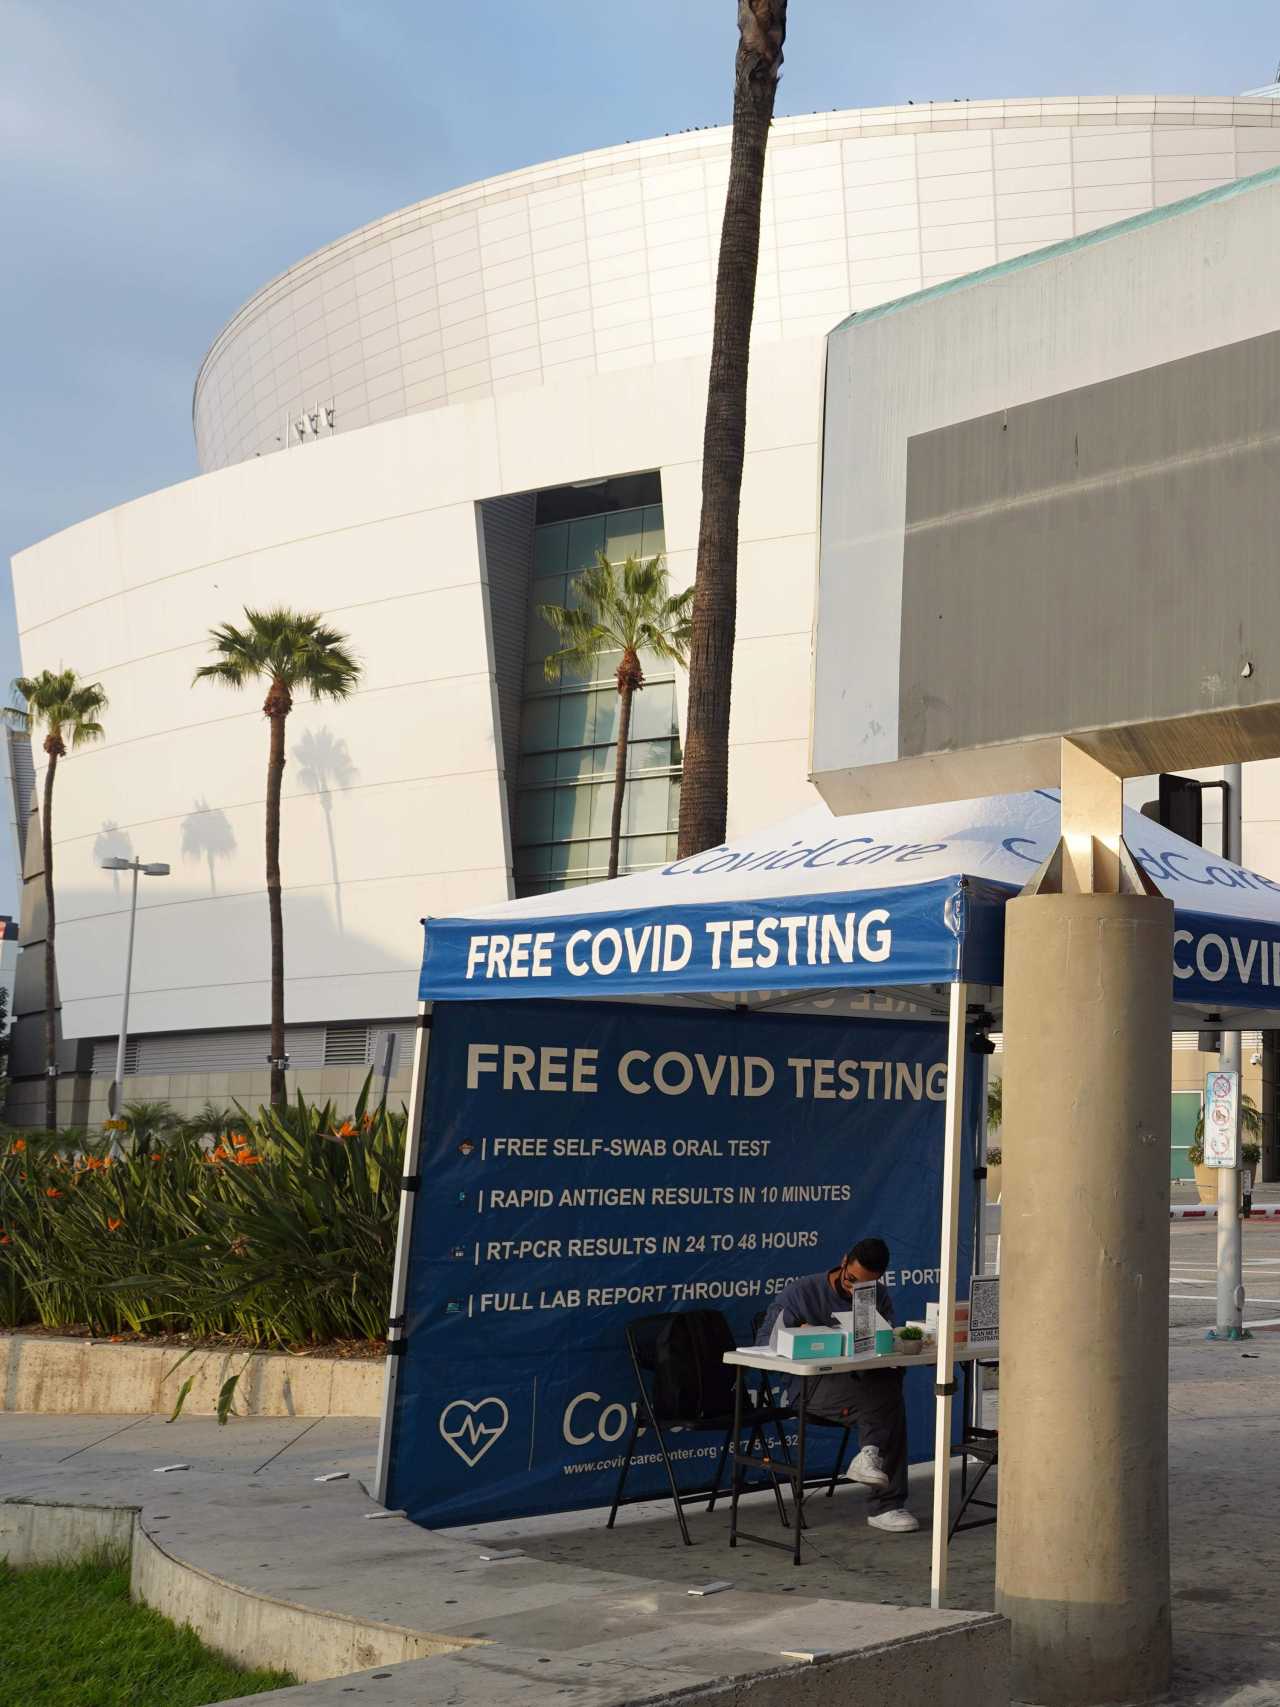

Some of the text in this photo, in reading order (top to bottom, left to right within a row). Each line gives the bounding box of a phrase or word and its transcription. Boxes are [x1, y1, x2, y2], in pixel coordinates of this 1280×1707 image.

[661, 837, 948, 876] CovidCare
[465, 909, 892, 980] FREE COVID TESTING
[466, 1043, 948, 1101] FREE COVID TESTING
[493, 1138, 771, 1157] FREE SELF-SWAB ORAL TEST
[490, 1184, 851, 1208] RAPID ANTIGEN RESULTS IN 10 MINUTES
[486, 1231, 818, 1260] RT-PCR RESULTS IN 24 TO 48 HOURS
[480, 1293, 533, 1312] FULL
[540, 1289, 581, 1309] LAB
[586, 1284, 667, 1306] REPORT
[671, 1279, 760, 1301] THROUGH
